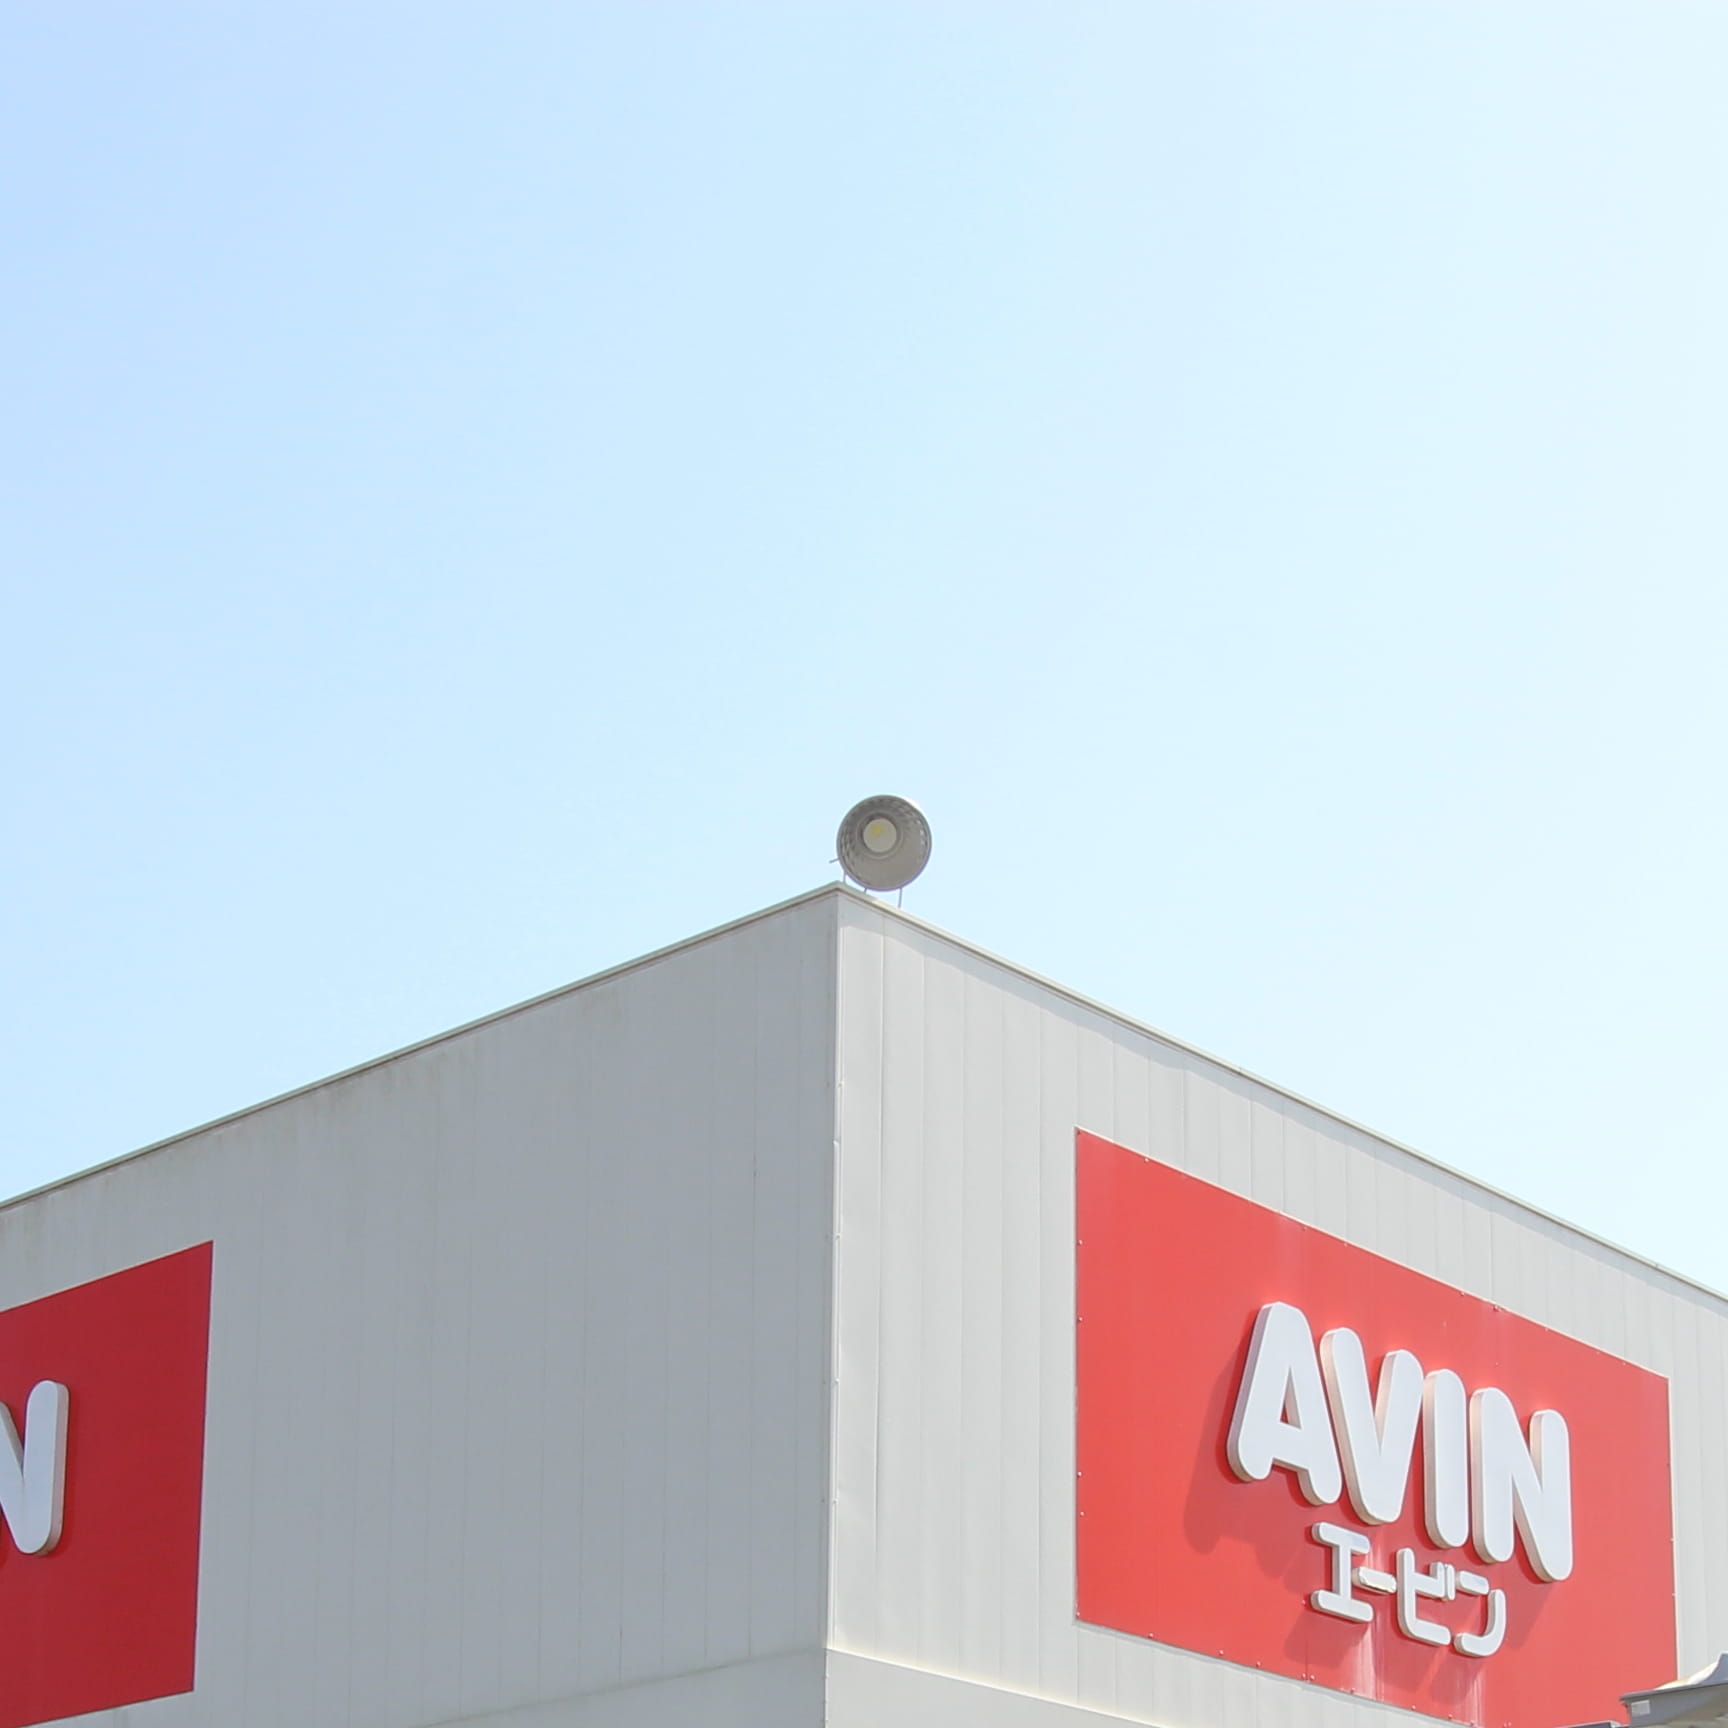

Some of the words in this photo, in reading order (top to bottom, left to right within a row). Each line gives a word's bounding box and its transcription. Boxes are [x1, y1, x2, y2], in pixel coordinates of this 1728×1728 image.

[1227, 1301, 1574, 1583] AVIN
[1311, 1522, 1506, 1657] エービン
